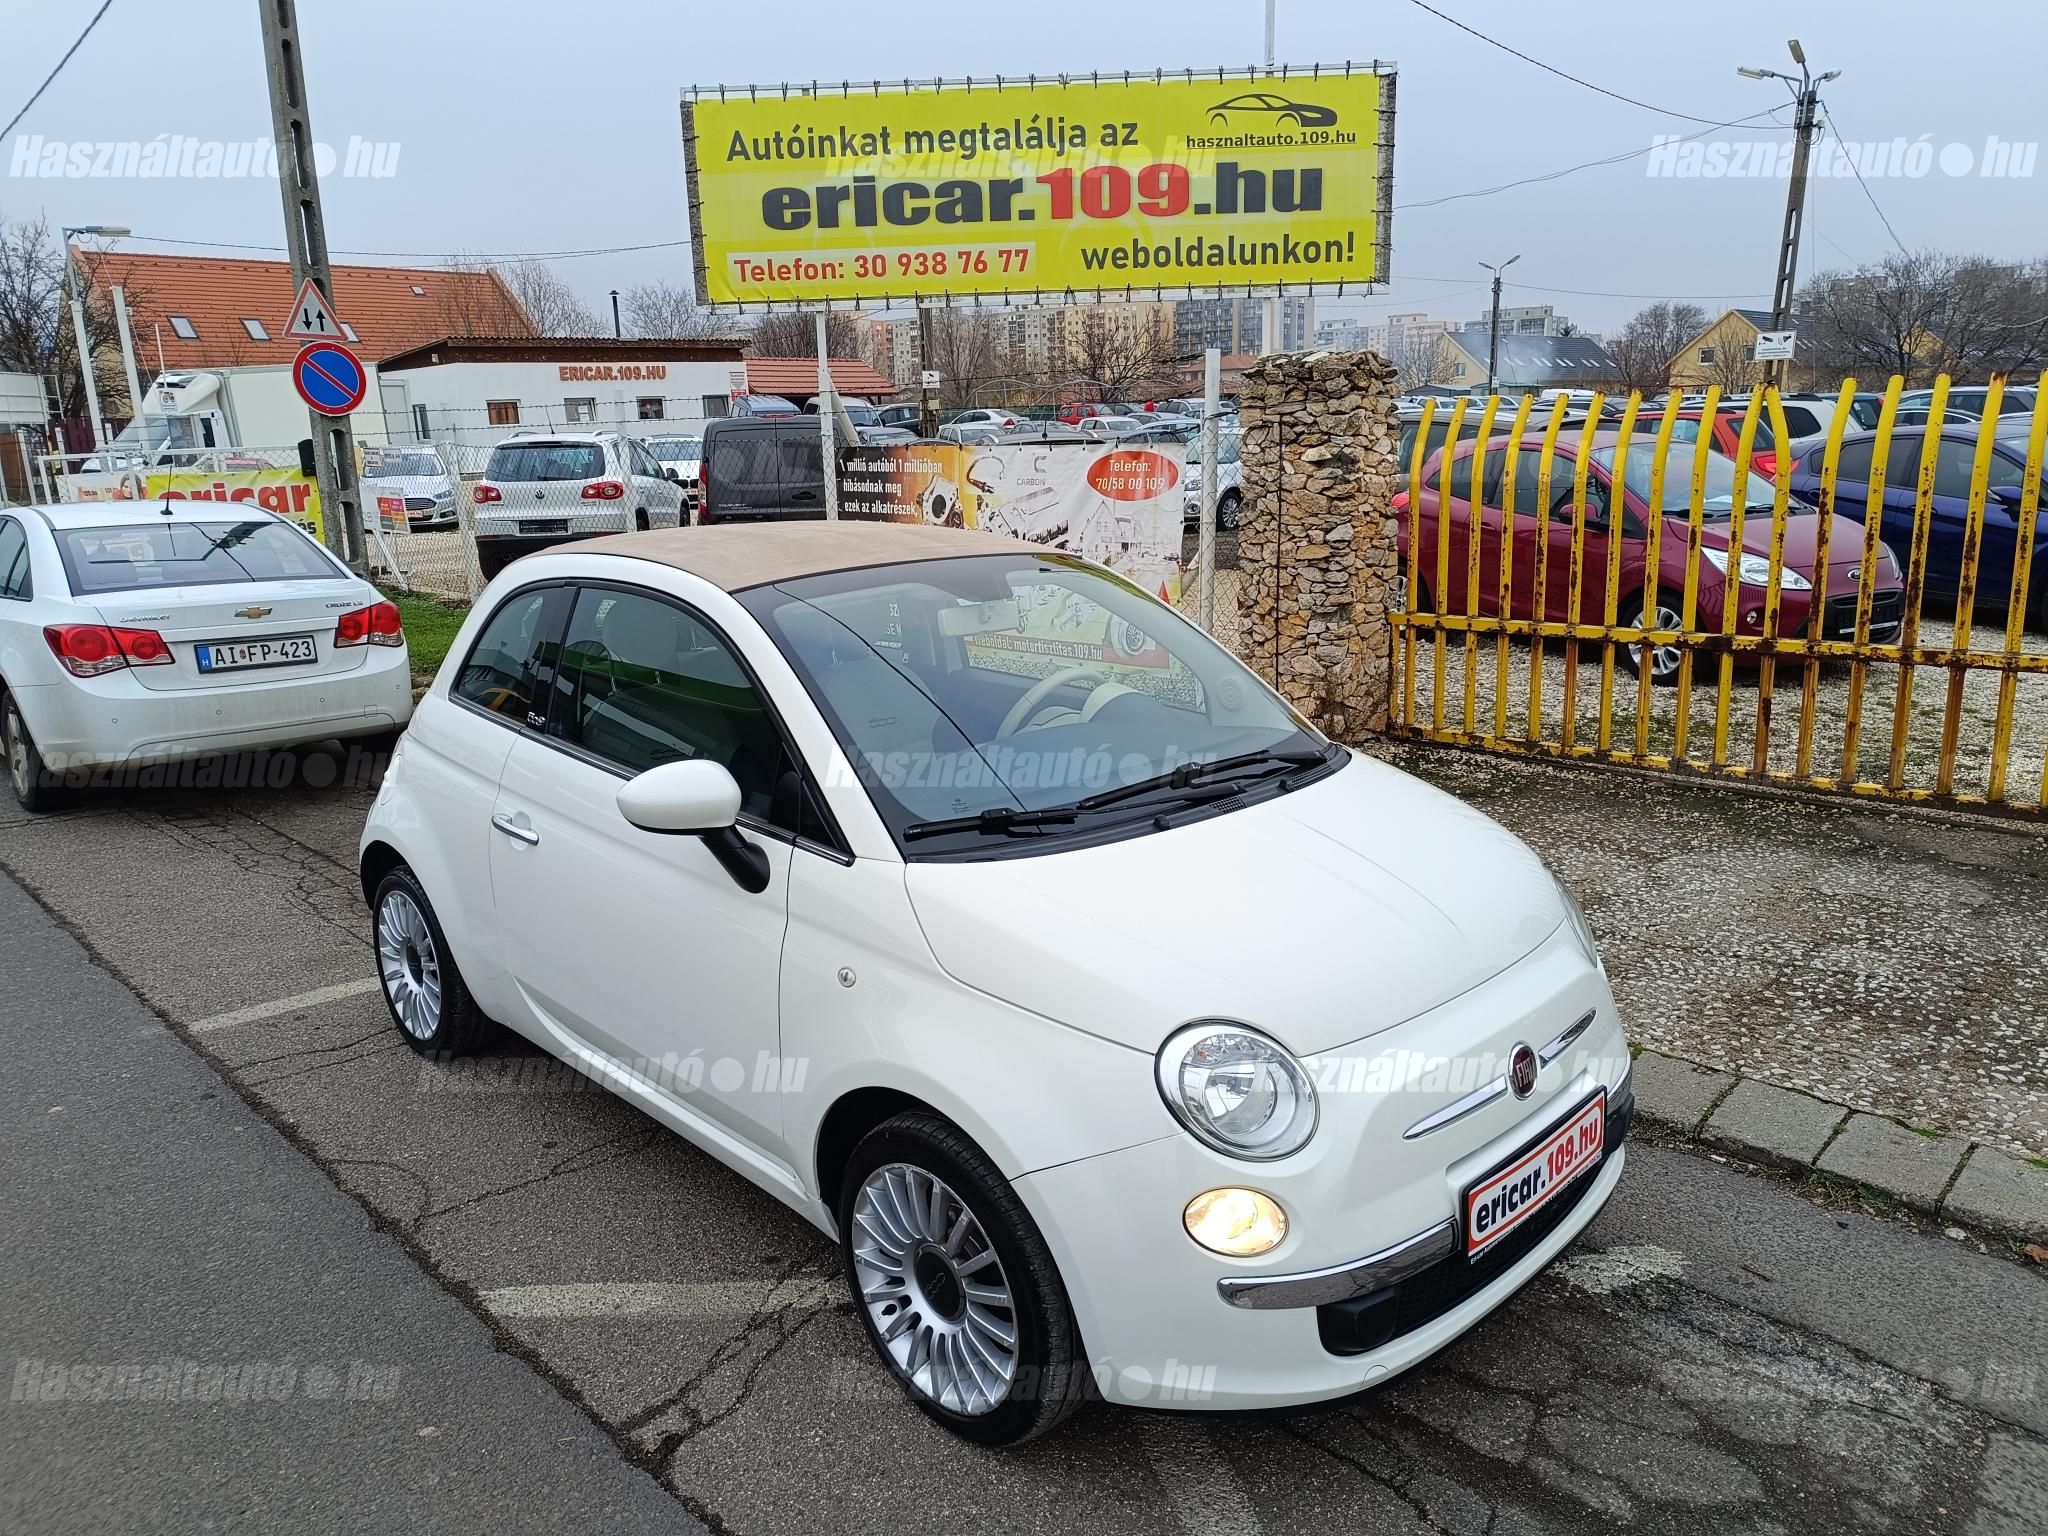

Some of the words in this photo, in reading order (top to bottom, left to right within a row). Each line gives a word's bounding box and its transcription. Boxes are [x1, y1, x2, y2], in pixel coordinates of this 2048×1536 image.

[727, 123, 891, 162] Autóinkat
[904, 113, 1087, 160] megtalálja
[1100, 122, 1139, 147] az
[1186, 130, 1356, 149] hasznaltauto.109.hu
[762, 160, 1323, 231] ericar.109.hu
[1081, 231, 1355, 271] weboldalunkon!
[733, 257, 845, 283] Telefon:
[854, 254, 888, 279] 30
[897, 252, 947, 277] 938
[957, 250, 988, 274] 76
[998, 248, 1029, 273] 77
[559, 365, 666, 382] ERICAR.109.HU
[868, 457, 897, 473] autóból
[904, 458, 943, 473] millióban
[1109, 460, 1151, 472] Telefon:
[843, 478, 883, 493] hibásodnak
[885, 482, 902, 496] meg
[1016, 478, 1046, 486] CARBON
[1095, 478, 1124, 490] 70/58
[1128, 478, 1142, 489] 00
[1145, 478, 1165, 490] 109
[844, 499, 860, 512] ezek
[861, 502, 870, 513] az
[871, 501, 918, 517] alkatrészek,
[203, 659, 209, 667] H
[214, 647, 237, 666] AI
[248, 640, 312, 663] FP-423
[1515, 1056, 1533, 1087] FIAT
[1476, 1118, 1598, 1234] ericar.109.hu
